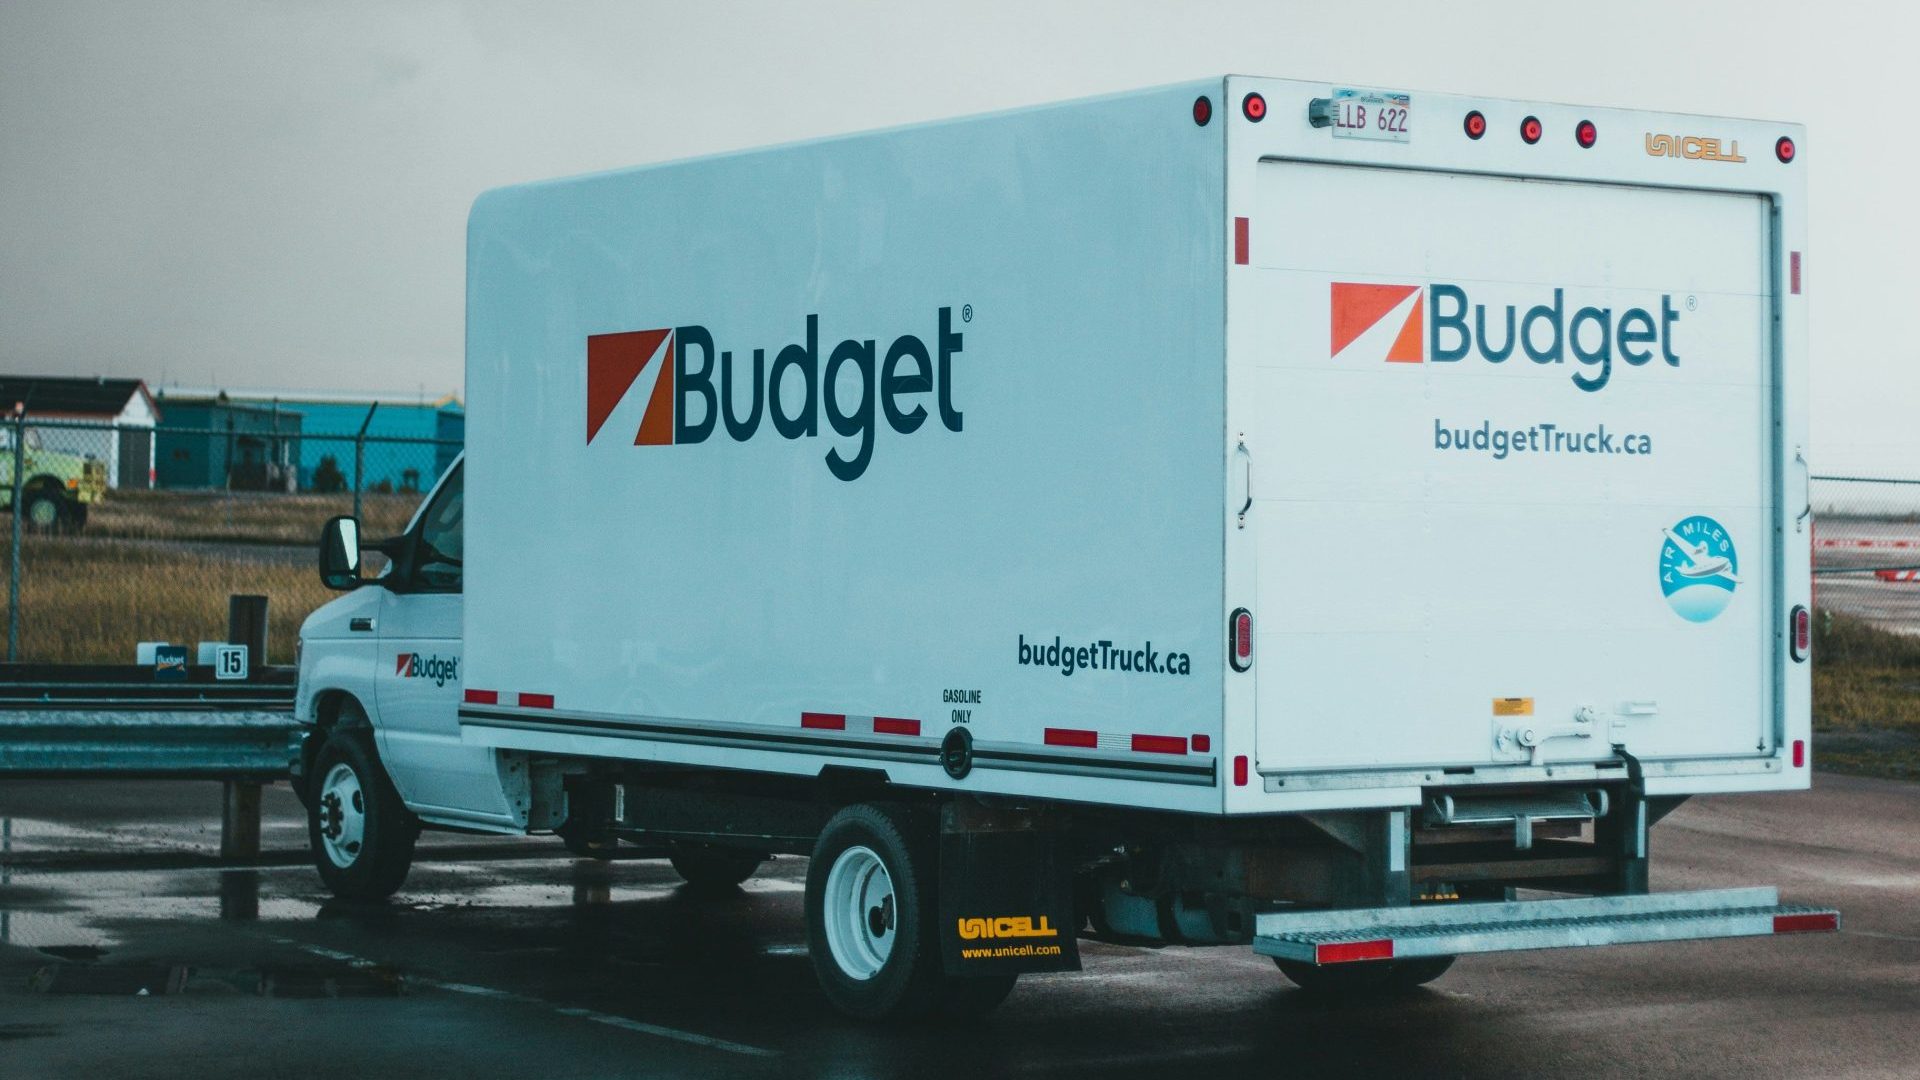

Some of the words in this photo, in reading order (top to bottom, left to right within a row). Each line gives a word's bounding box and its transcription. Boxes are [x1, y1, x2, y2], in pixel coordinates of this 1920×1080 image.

[1378, 108, 1408, 132] 622
[1645, 132, 1747, 163] UNICELL
[1429, 283, 1680, 393] Budget
[674, 306, 963, 482] Budget
[1434, 418, 1652, 460] budgetTruck.ca
[1663, 546, 1676, 584] AIR
[1682, 521, 1730, 552] MILES
[222, 651, 241, 673] 15
[411, 652, 458, 688] Budget
[1018, 634, 1191, 677] budgetTruck.ca
[943, 689, 982, 704] GASOLINE
[951, 709, 972, 724] ONLY
[958, 915, 1058, 940] UNICELL
[962, 944, 1061, 959] www.unicell.com
